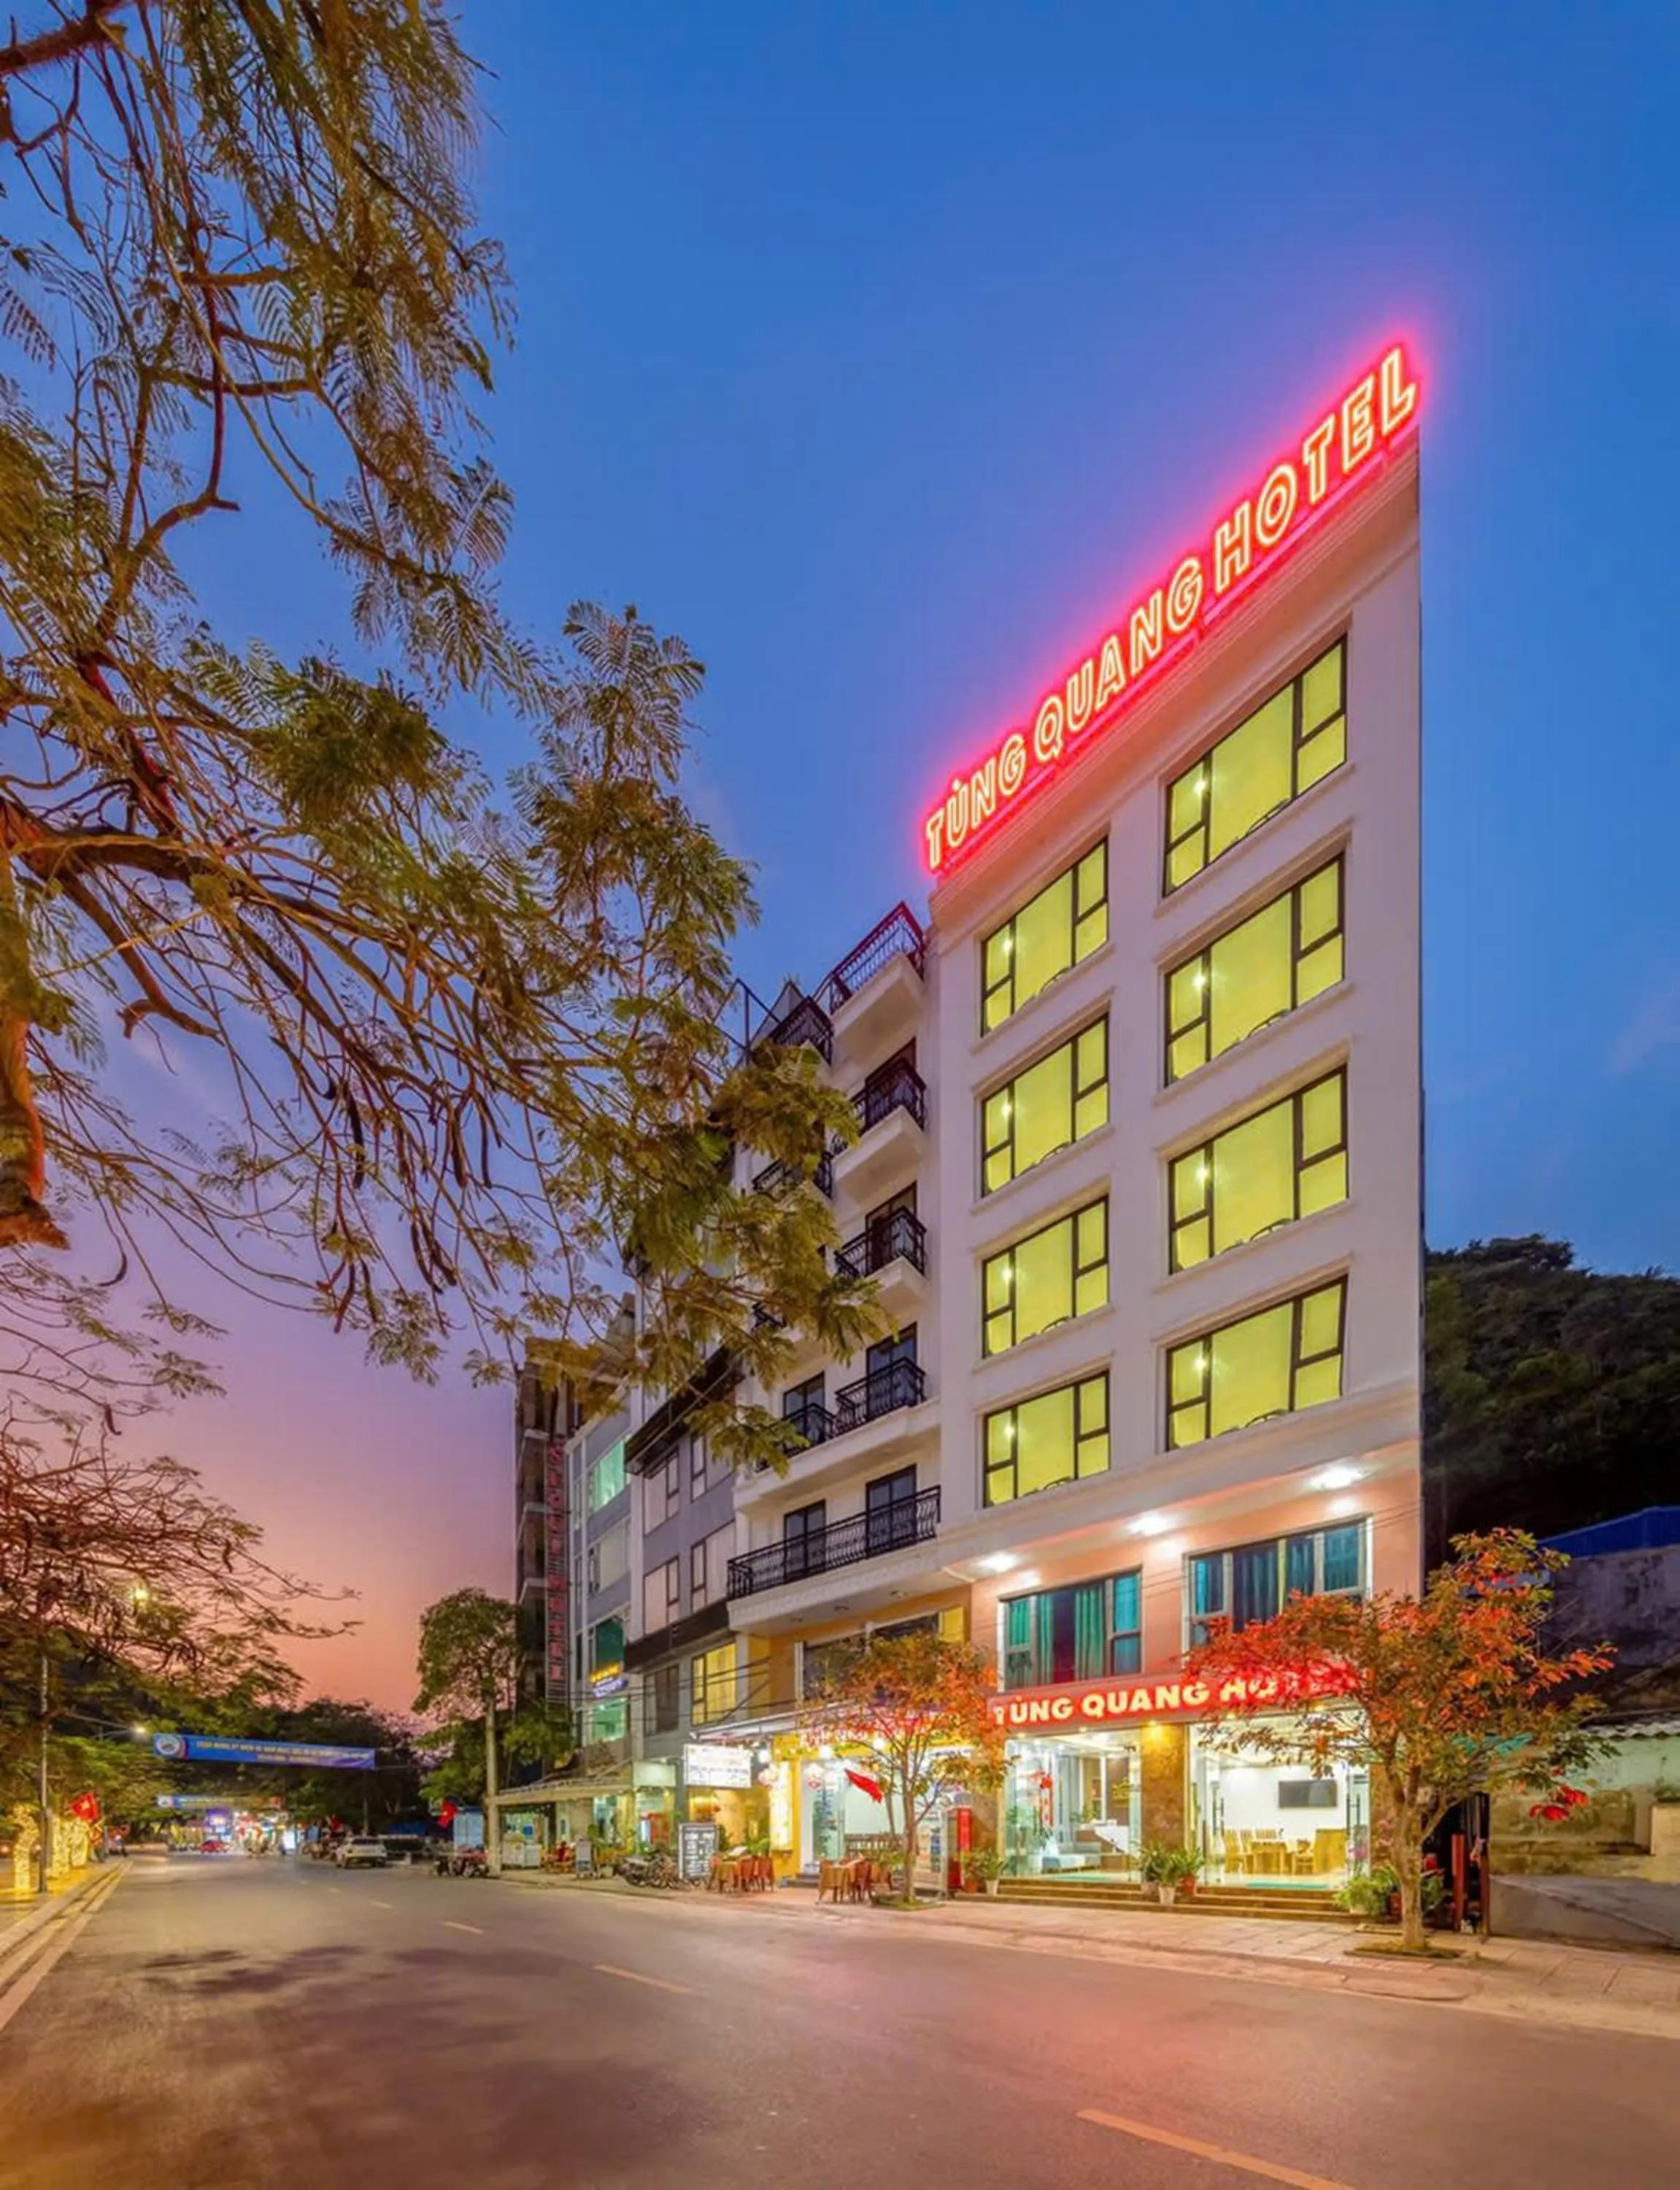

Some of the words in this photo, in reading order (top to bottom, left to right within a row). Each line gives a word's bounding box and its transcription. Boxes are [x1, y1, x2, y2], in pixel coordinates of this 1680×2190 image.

[1033, 557, 1203, 762] QUANG
[1214, 347, 1417, 594] HOTEL
[1081, 1682, 1210, 1718] QUANG
